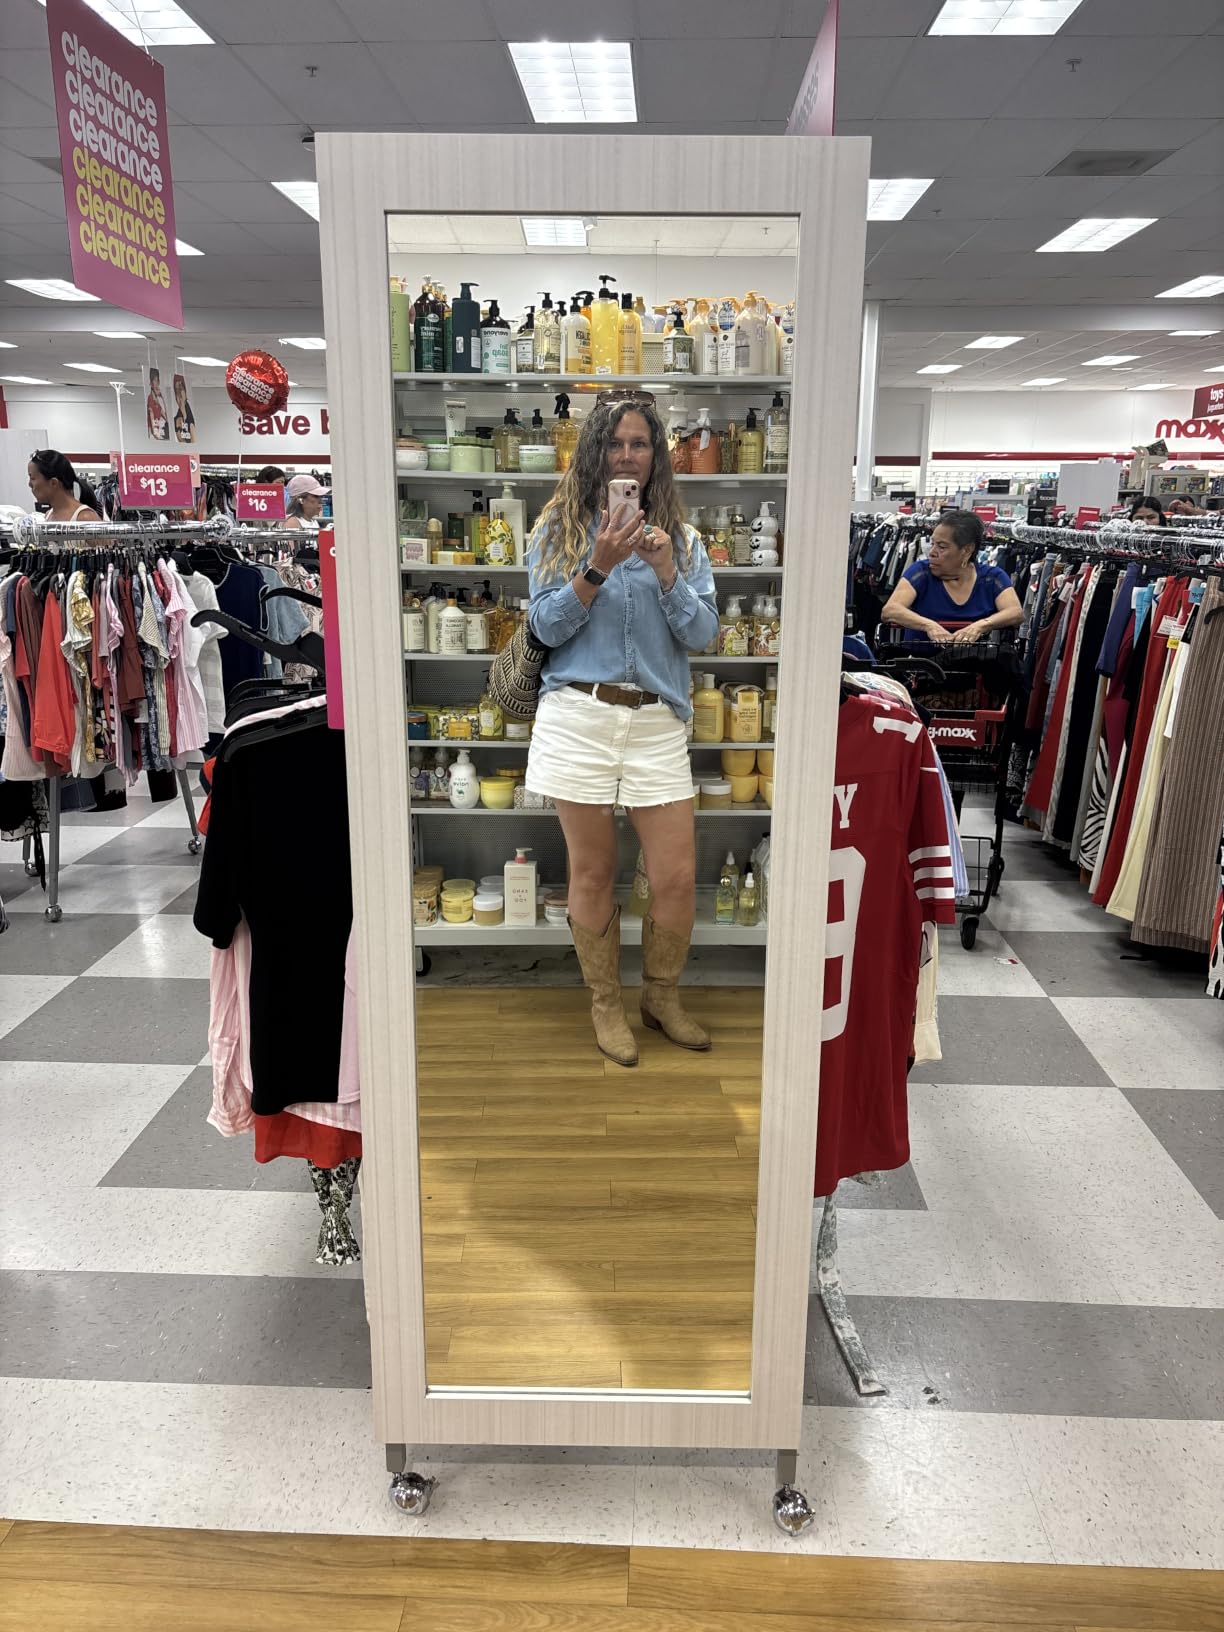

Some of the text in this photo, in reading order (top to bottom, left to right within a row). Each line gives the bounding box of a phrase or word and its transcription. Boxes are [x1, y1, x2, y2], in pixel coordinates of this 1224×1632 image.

[61, 30, 158, 127] clearance
[65, 69, 160, 159] clearance
[69, 108, 163, 193] clearance
[72, 146, 165, 225] clearance
[76, 183, 168, 257] clearance
[79, 220, 171, 289] clearance
[232, 371, 273, 400] clearance
[233, 366, 275, 396] clearance
[1210, 387, 1224, 403] toys
[238, 414, 311, 435] save
[128, 463, 181, 474] clearance
[140, 477, 168, 497] $13
[241, 488, 277, 498] clearance
[248, 497, 268, 511] $16
[833, 783, 858, 829] Y
